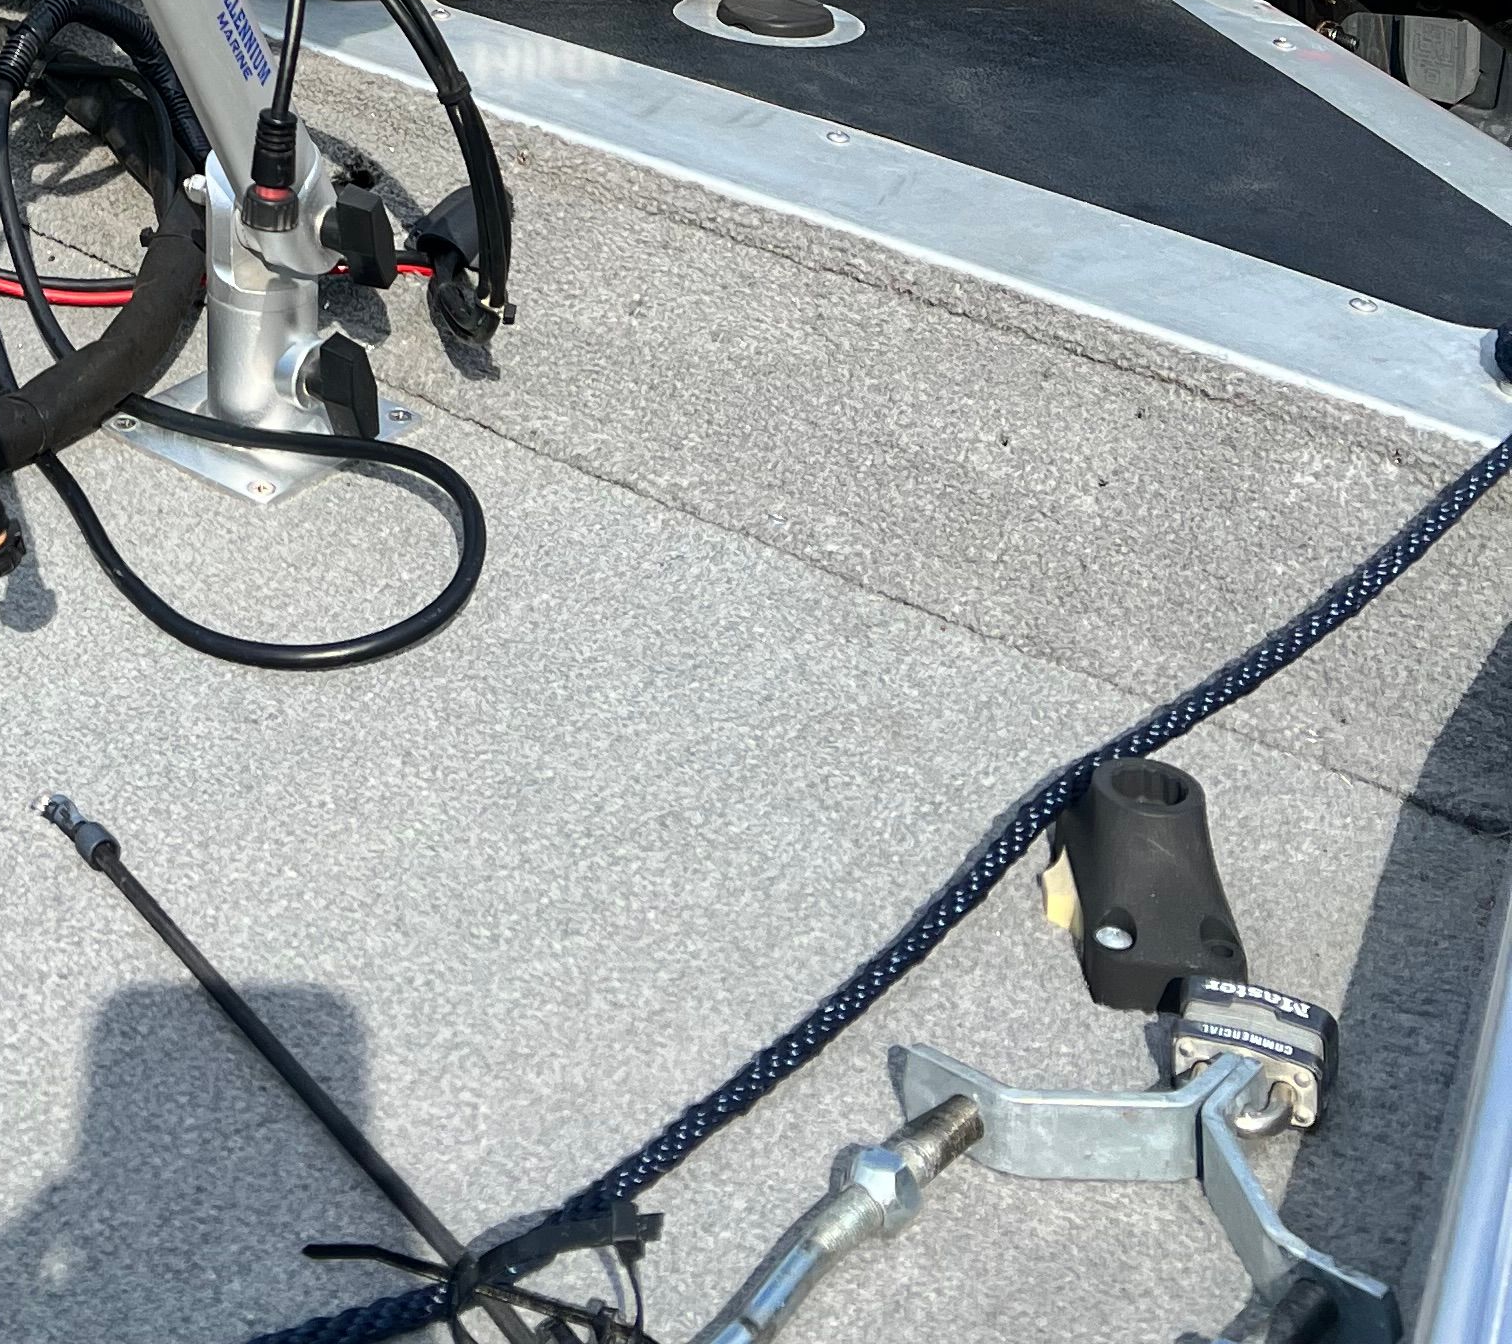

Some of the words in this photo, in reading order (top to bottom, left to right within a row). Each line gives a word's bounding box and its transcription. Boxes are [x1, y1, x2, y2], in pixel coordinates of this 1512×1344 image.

[217, 10, 254, 82] MARINE
[1202, 979, 1311, 1019] Master
[1201, 1024, 1293, 1056] COMMERCIAL
